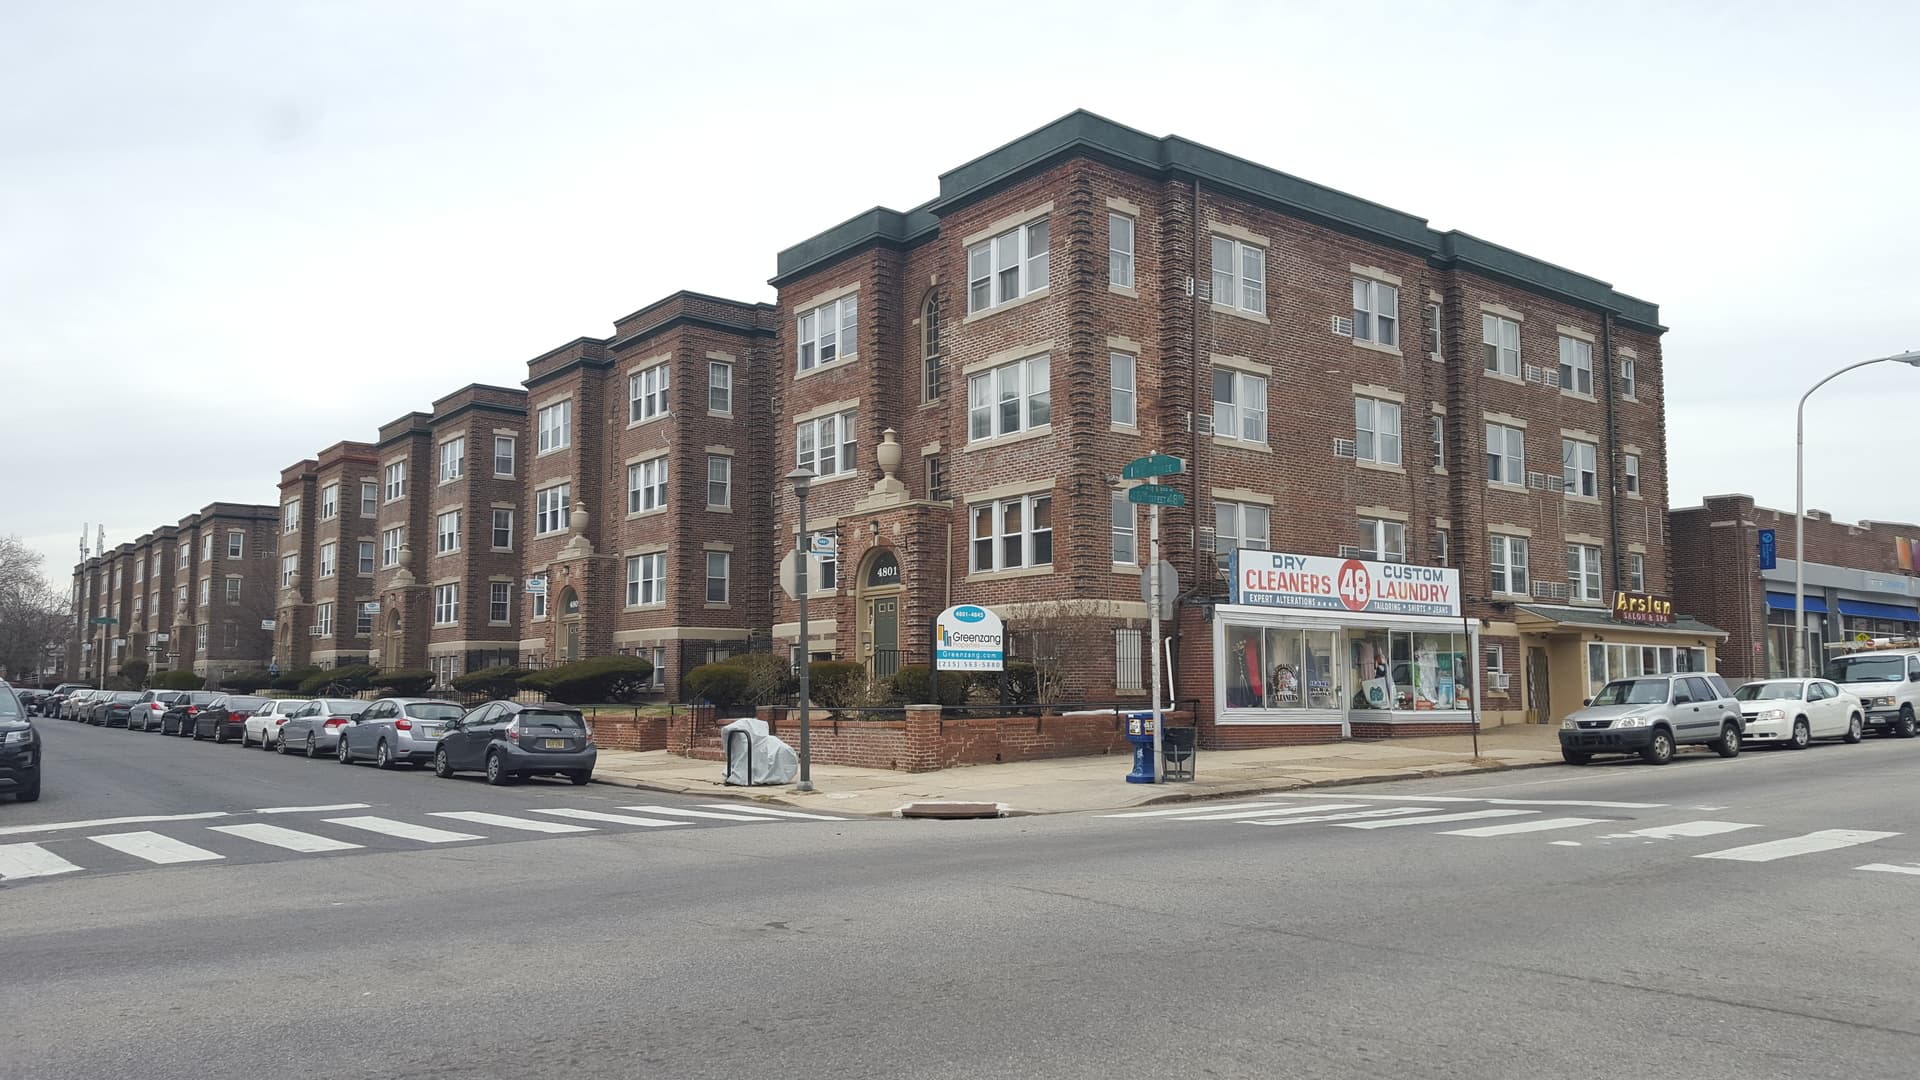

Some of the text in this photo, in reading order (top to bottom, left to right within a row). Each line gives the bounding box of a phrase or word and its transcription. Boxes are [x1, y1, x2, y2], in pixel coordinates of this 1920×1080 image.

[1272, 554, 1307, 570] DRY
[877, 566, 898, 577] 4801
[1383, 565, 1444, 582] CUSTOM
[1245, 568, 1332, 595] CLEANERS
[1340, 568, 1368, 602] 48
[1249, 593, 1273, 604] EXPERT
[1376, 579, 1450, 603] LAUNDRY
[1374, 601, 1449, 614] TAILORING SHIRTS JEANS
[1616, 592, 1671, 615] Arslan
[1623, 612, 1646, 620] SALON
[1656, 614, 1668, 622] SPA
[952, 631, 1001, 646] Greenzang
[942, 651, 997, 660] Greenzang.com
